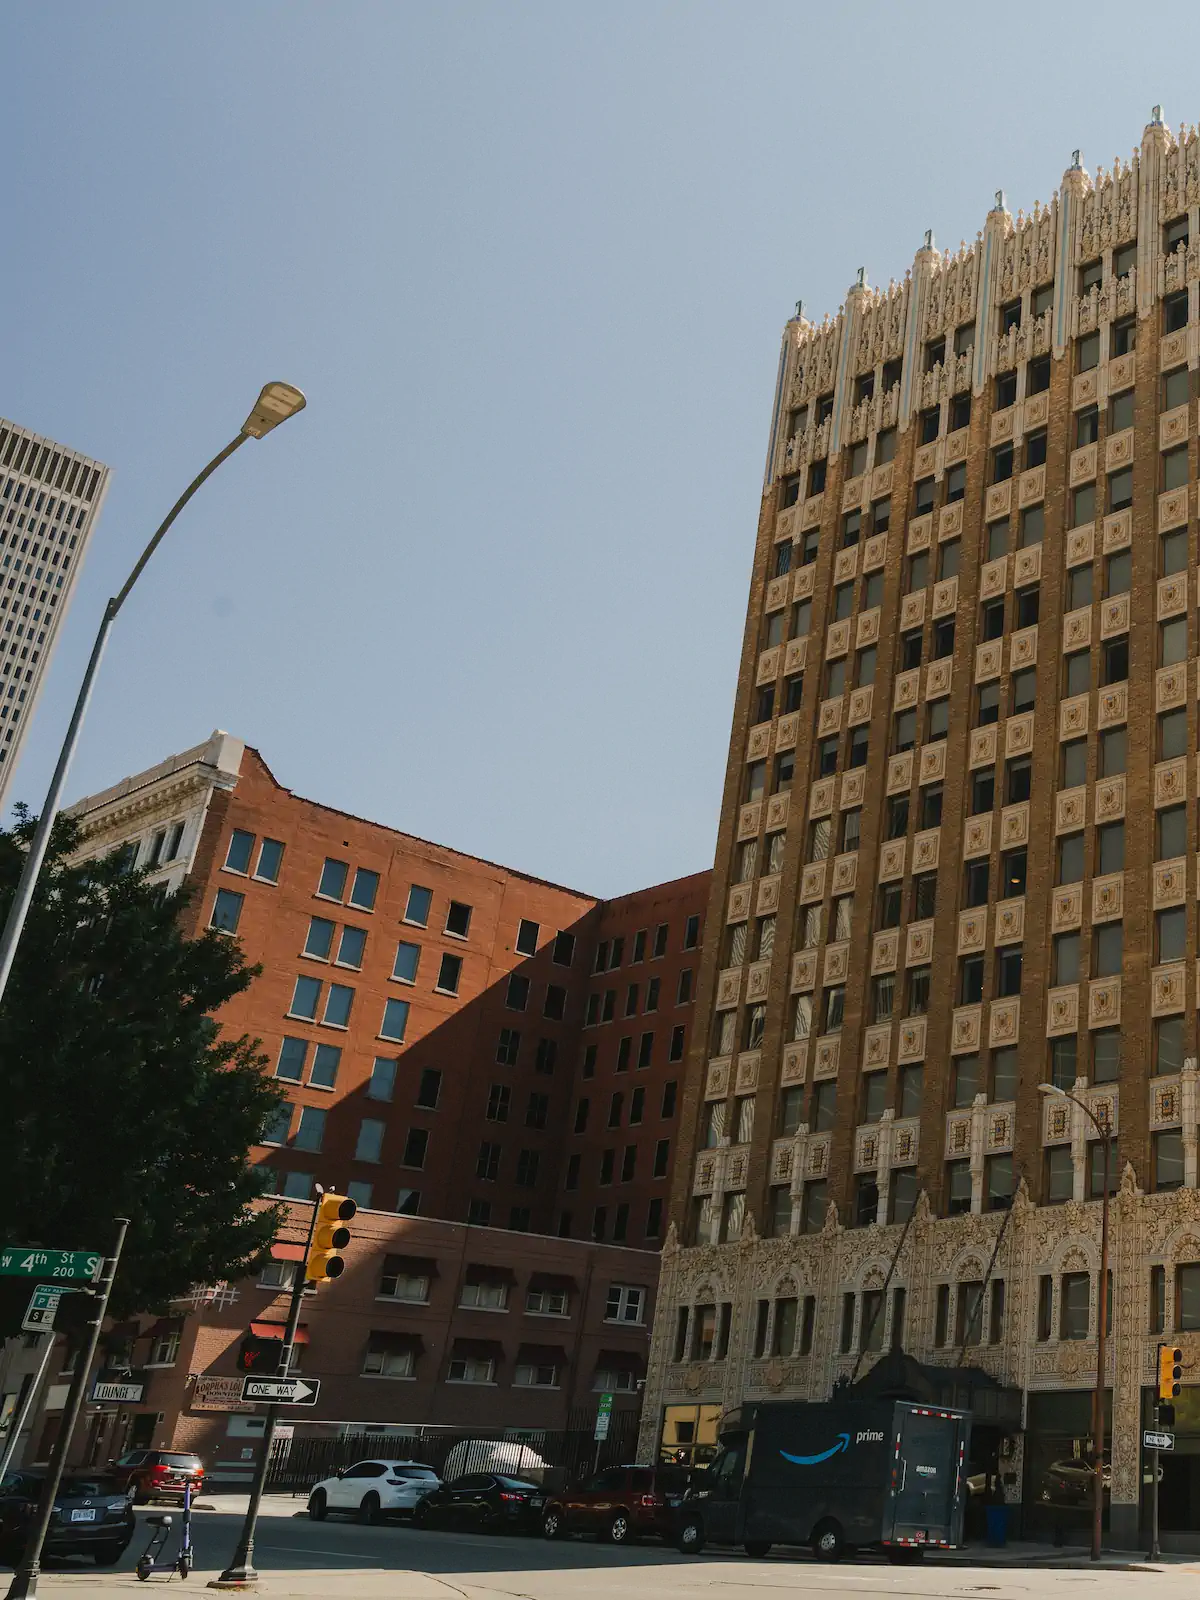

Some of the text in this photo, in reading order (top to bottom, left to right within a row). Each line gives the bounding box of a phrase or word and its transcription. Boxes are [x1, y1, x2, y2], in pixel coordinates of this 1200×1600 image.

[2, 1255, 13, 1267] W
[20, 1253, 47, 1272] 4th
[60, 1252, 76, 1264] St
[52, 1266, 75, 1277] 200
[250, 1384, 297, 1396] ONE WAY
[856, 1429, 884, 1444] prime
[916, 1465, 936, 1473] amazon
